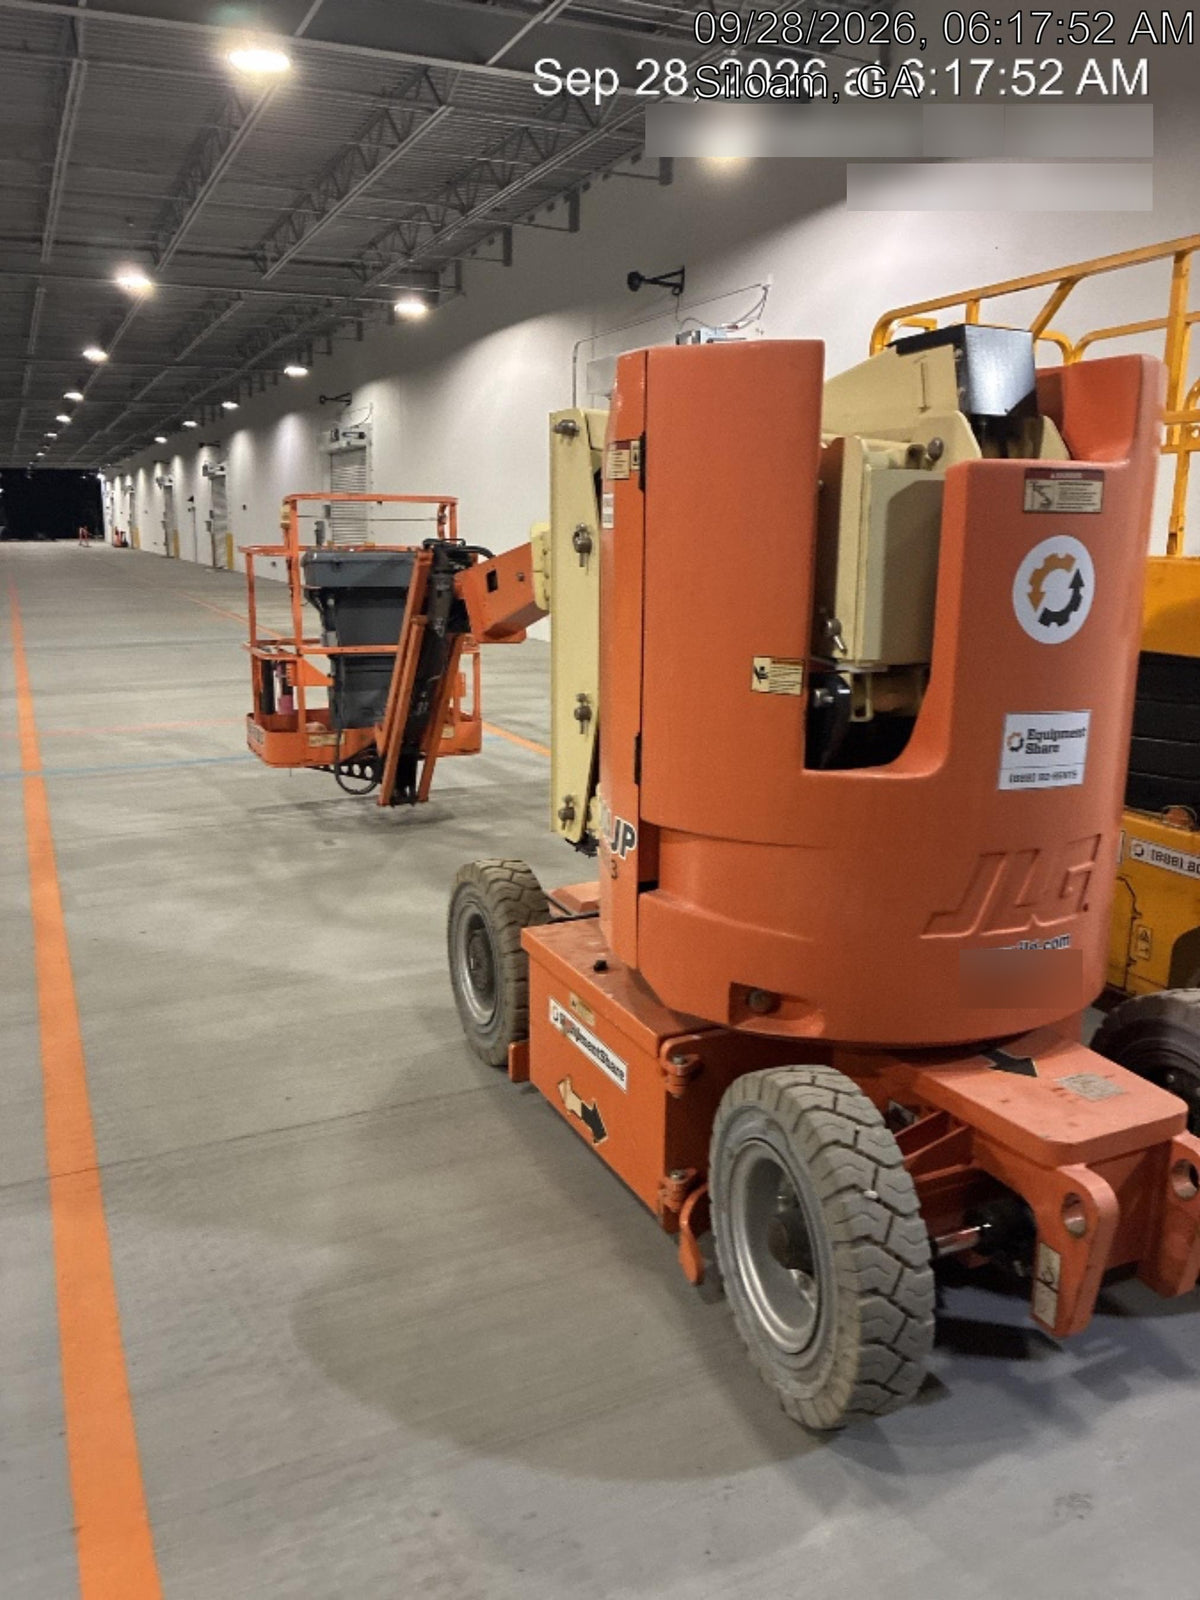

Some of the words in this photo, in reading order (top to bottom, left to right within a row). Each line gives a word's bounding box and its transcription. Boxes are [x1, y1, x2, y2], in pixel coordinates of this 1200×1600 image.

[1026, 727, 1087, 743] Equipment
[1024, 742, 1061, 755] Share
[559, 1011, 625, 1082] EuipmentShare
